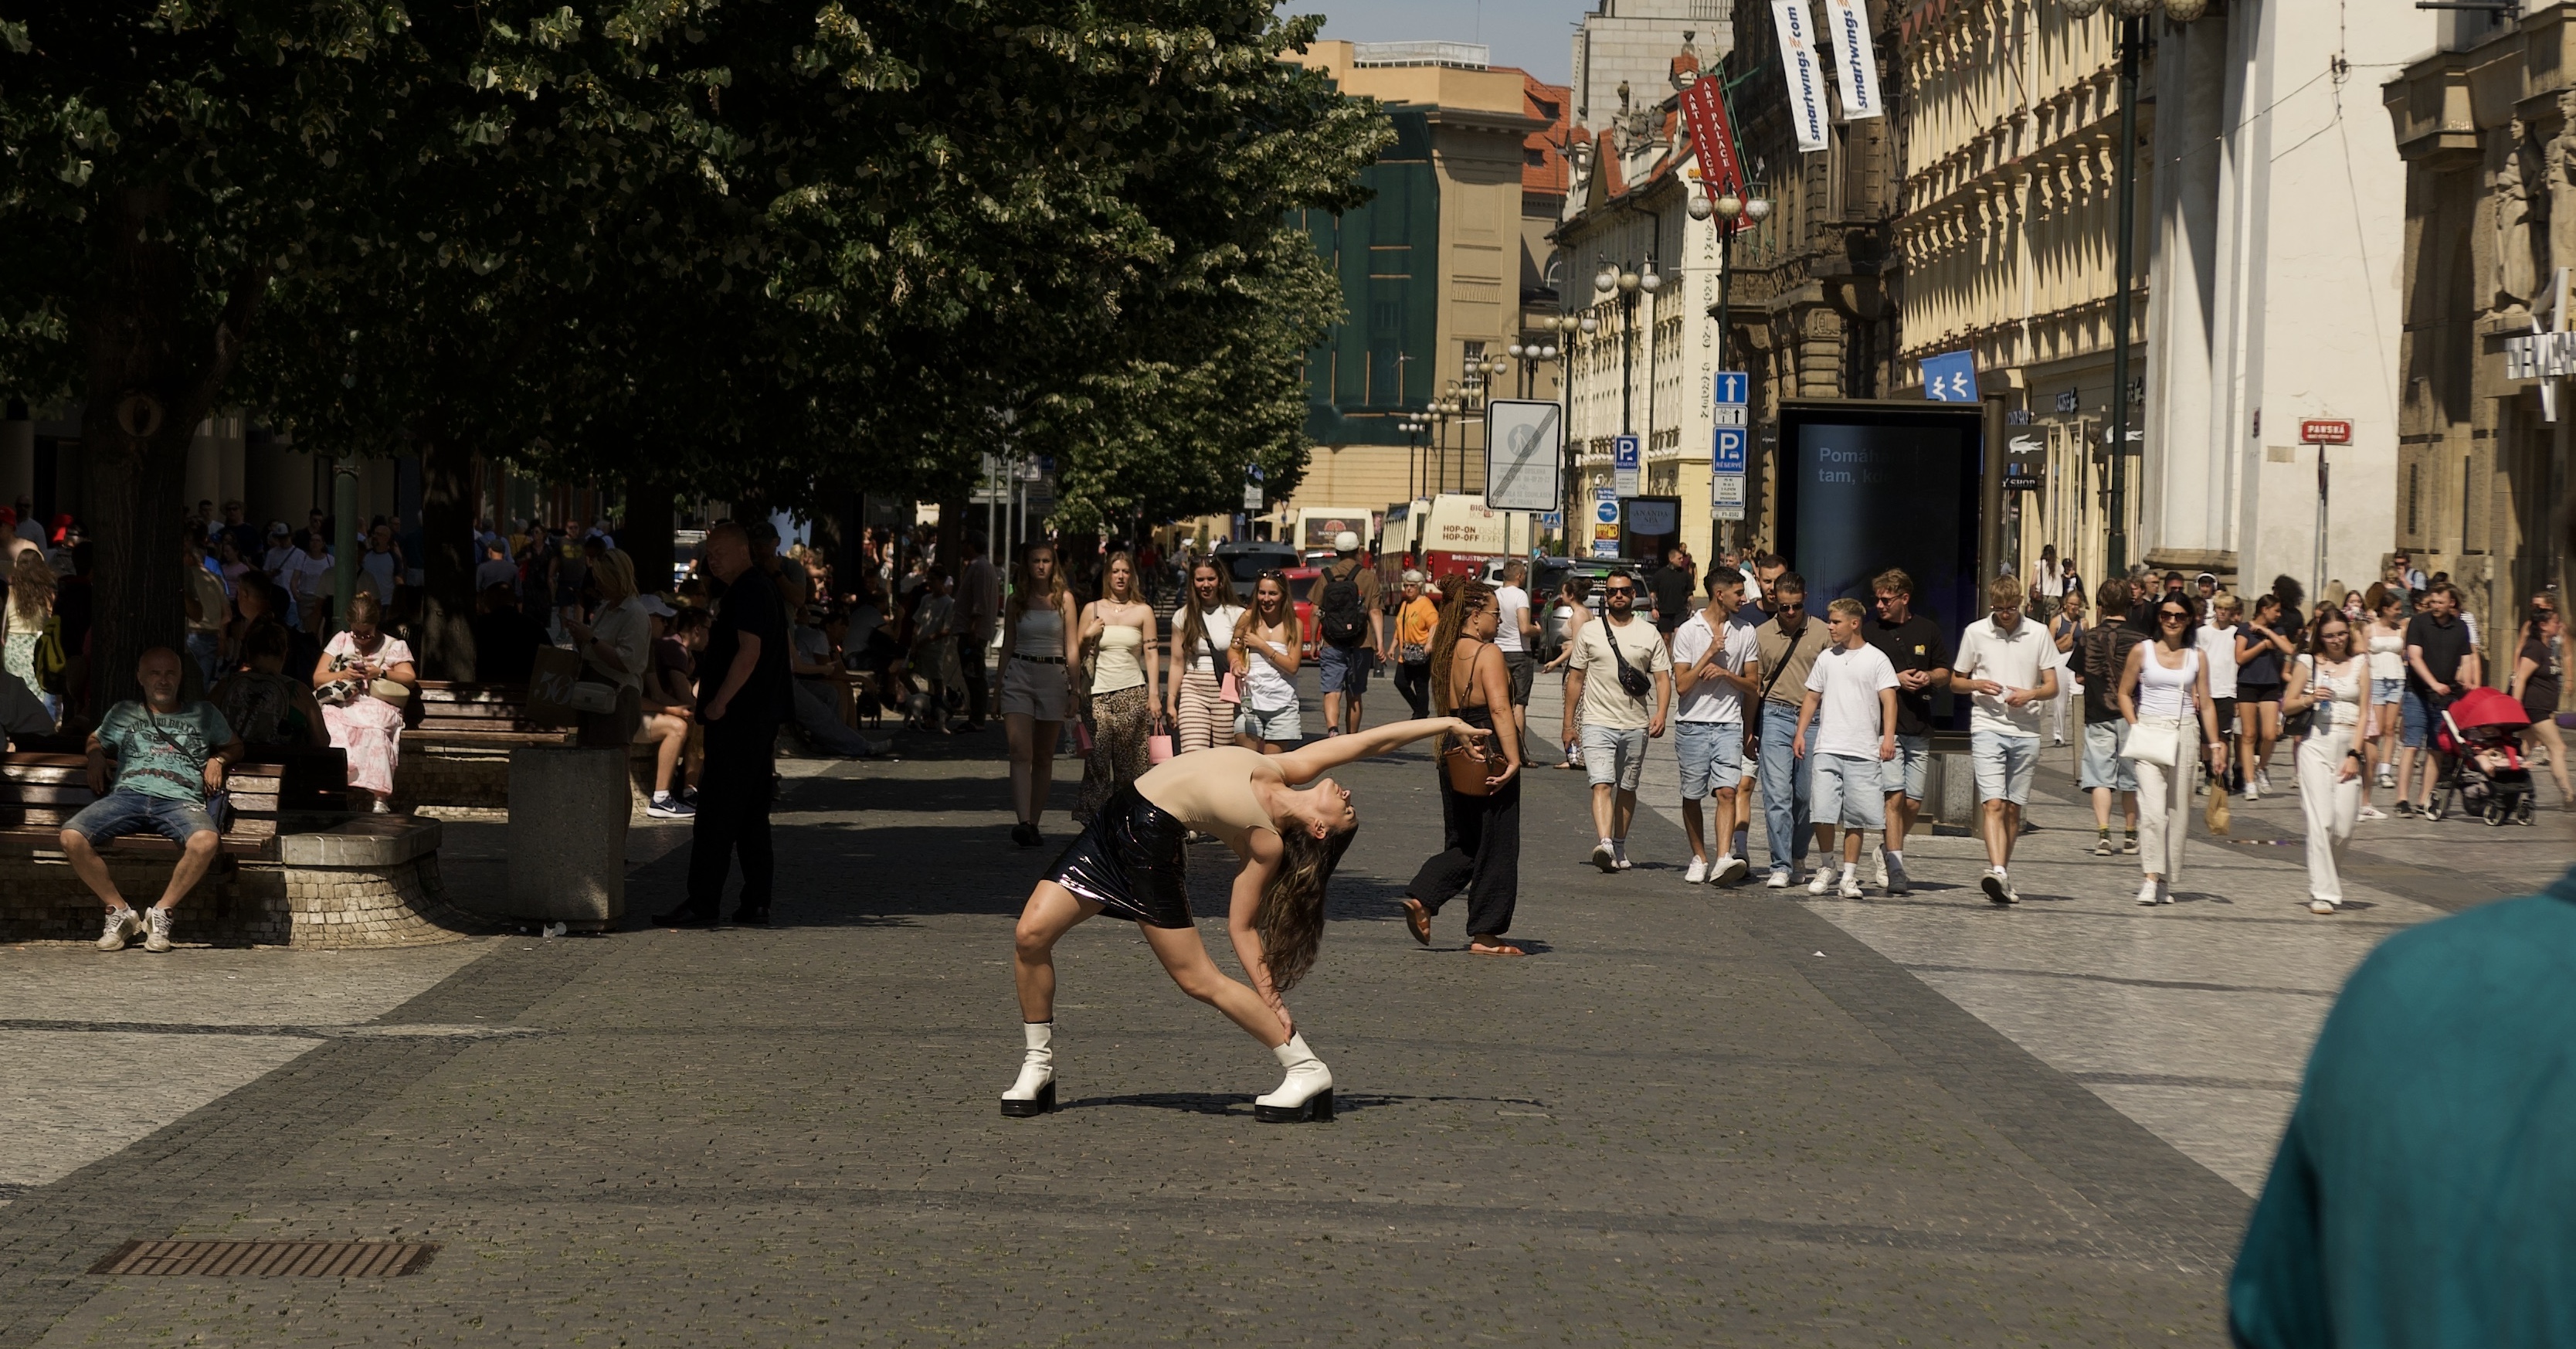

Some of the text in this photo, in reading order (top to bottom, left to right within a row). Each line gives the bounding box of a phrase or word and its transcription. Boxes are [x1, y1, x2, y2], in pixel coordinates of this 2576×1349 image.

[1794, 50, 1821, 141] smartwings
[1844, 9, 1868, 109] smartwings
[1688, 93, 1716, 177] ART PALACE
[1703, 81, 1715, 109] ART
[1711, 112, 1730, 168] PALACE
[1443, 533, 1480, 542] HOP-OFF
